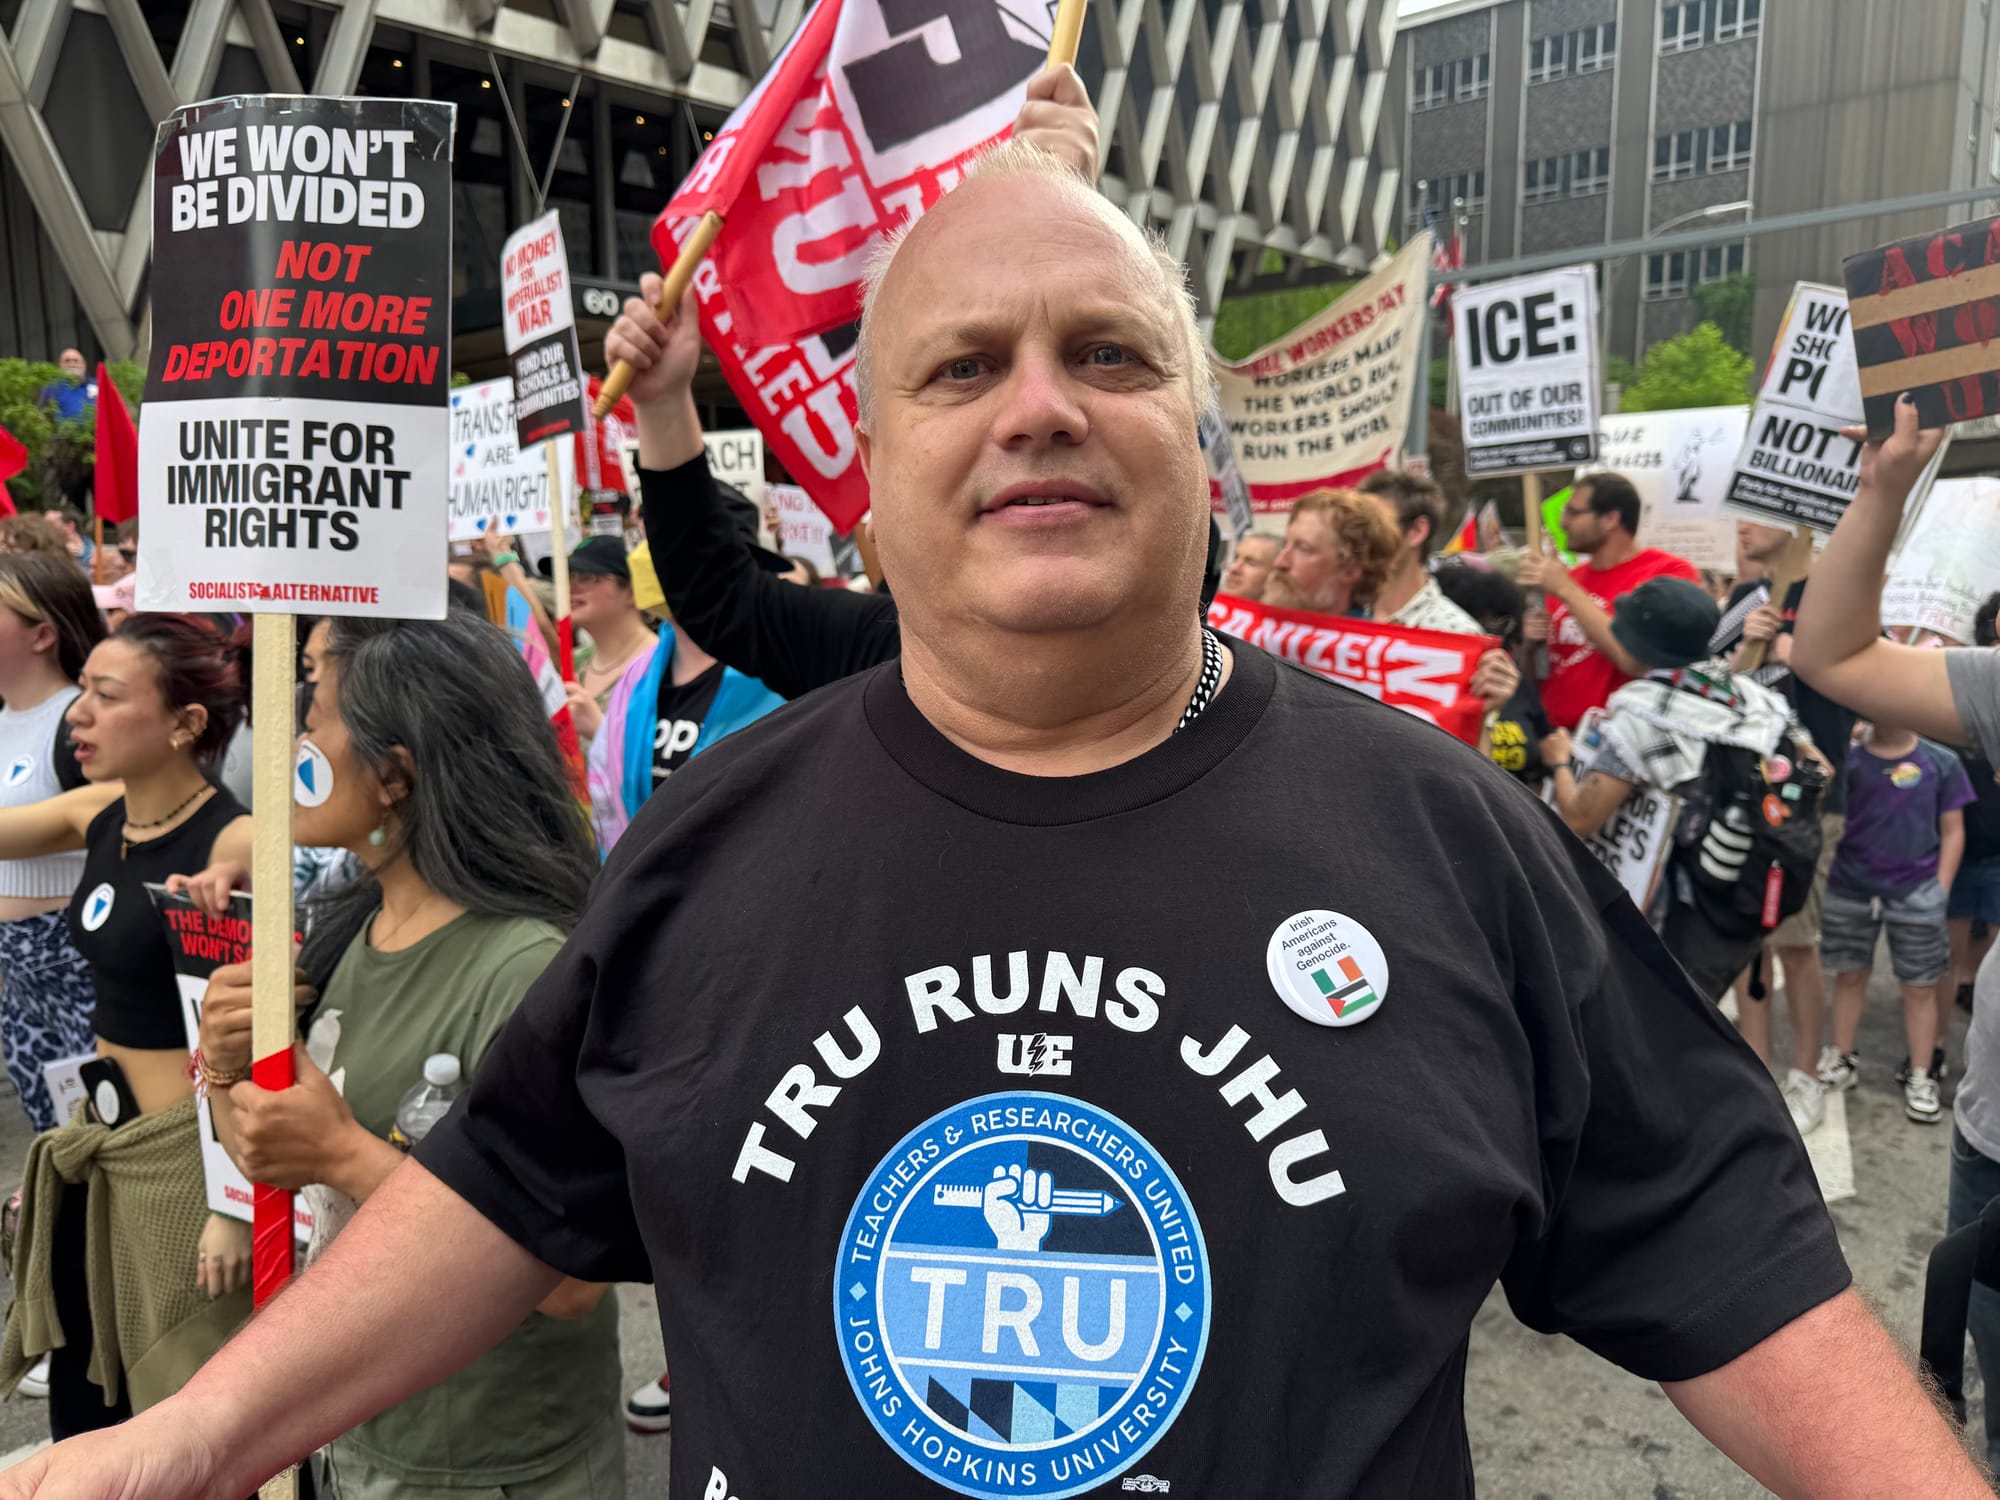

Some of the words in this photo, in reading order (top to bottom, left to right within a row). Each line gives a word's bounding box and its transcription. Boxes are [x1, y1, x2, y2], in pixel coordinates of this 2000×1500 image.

[178, 128, 237, 181] WE
[246, 125, 414, 178] WON'T
[172, 180, 219, 232] BE
[227, 175, 425, 229] DIVIDED
[275, 241, 373, 283] NOT
[517, 229, 558, 271] MONEY
[219, 289, 296, 331] ONE
[299, 290, 433, 335] MORE
[506, 268, 563, 316] IMPERIALIST
[583, 287, 620, 316] 60
[518, 298, 554, 337] WAR
[1466, 291, 1577, 368] ICE:
[161, 337, 440, 385] DEPORTATION
[540, 342, 565, 368] OUR
[1245, 395, 1283, 413] THE
[1291, 376, 1361, 408] WORLD
[1469, 393, 1503, 417] OUT
[1510, 389, 1536, 411] OF
[1540, 382, 1582, 407] OUR
[179, 419, 290, 461] UNITE
[302, 421, 395, 466] FOR
[454, 402, 503, 443] TRANS
[1230, 411, 1330, 436] WORKERS
[1470, 408, 1584, 438] COMMUNITIES!
[1759, 415, 1839, 462] NOT
[483, 445, 514, 468] ARE
[1243, 444, 1287, 461] RUN
[1298, 436, 1333, 456] THE
[168, 463, 411, 510] IMMIGRANT
[505, 473, 549, 512] RIGHT
[205, 507, 359, 551] RIGHTS
[189, 582, 254, 601] SOCIALIST
[273, 583, 379, 604] ALTERNATIVE
[165, 909, 204, 934] THE
[1281, 918, 1338, 951] Americans
[1289, 914, 1315, 932] Irish
[180, 932, 231, 964] WON'T
[1296, 932, 1337, 958] against
[1296, 942, 1351, 971] Genocide.
[731, 1004, 881, 1184] TRU
[904, 950, 1166, 1034] RUNS
[1179, 1023, 1347, 1207] JHU
[851, 1138, 940, 1264] TEACHERS
[944, 1125, 963, 1145] &
[971, 1107, 1149, 1180] RESEARCHERS
[1144, 1179, 1195, 1285] UNITED
[910, 1266, 1127, 1362] TRU
[849, 1316, 902, 1418] JOHNS
[902, 1419, 1036, 1486] HOPKINS
[1051, 1337, 1188, 1482] UNIVERSITY
